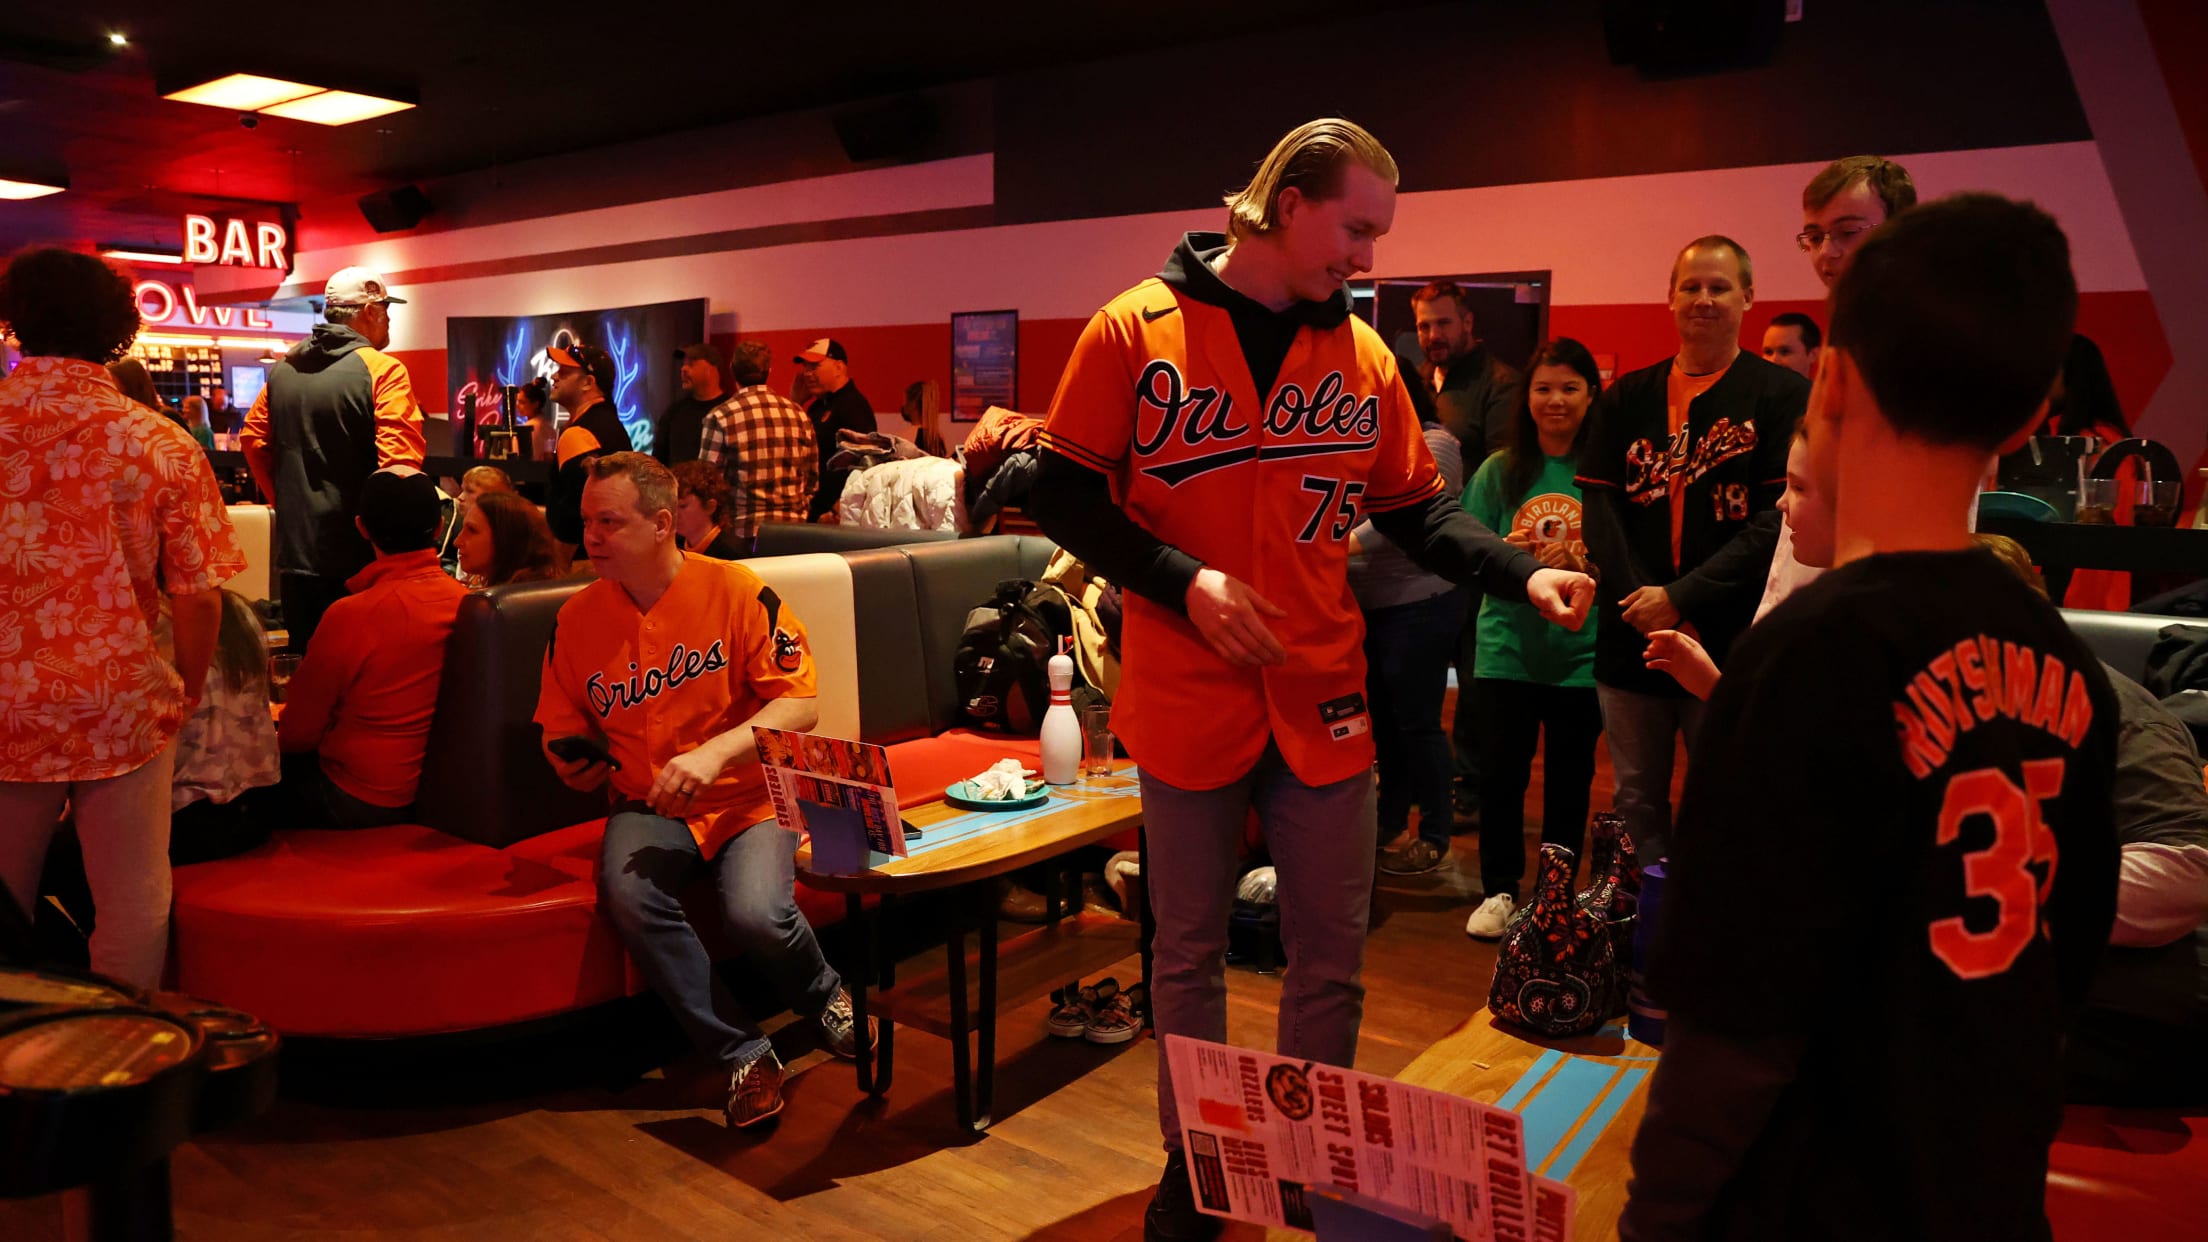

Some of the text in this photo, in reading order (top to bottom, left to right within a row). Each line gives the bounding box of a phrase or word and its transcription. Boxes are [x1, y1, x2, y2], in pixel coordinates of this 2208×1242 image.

[185, 214, 288, 270] BAR
[1296, 474, 1368, 543] 75
[1521, 501, 1581, 529] BIRDLAND
[1711, 483, 1749, 522] 18
[586, 639, 728, 718] Orioles
[765, 766, 790, 828] STARTERS
[1221, 1136, 1248, 1175] MENU
[1316, 1070, 1359, 1192] SWEET SPOT
[1484, 1111, 1518, 1158] GET
[1242, 1140, 1270, 1179] KIDS
